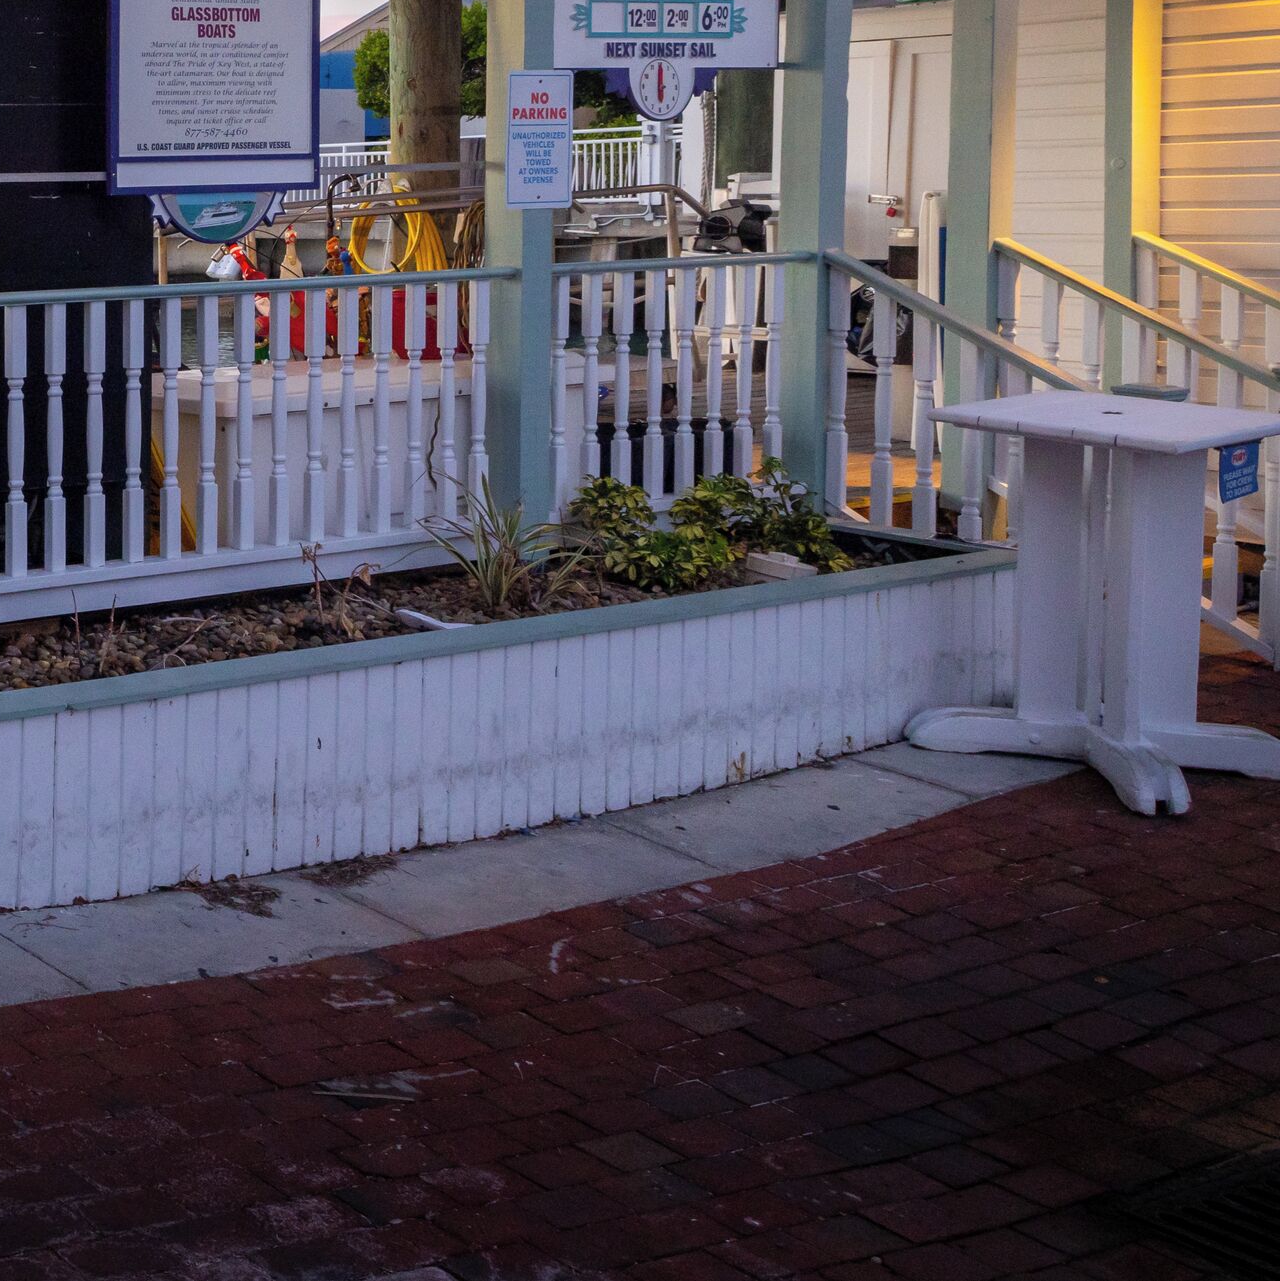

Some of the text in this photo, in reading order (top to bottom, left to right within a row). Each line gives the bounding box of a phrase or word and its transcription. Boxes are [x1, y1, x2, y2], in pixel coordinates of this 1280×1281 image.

[171, 7, 260, 22] GLASSBOTTOM
[629, 6, 728, 30] 12:00 2:00 6:00
[198, 24, 235, 38] BOATS
[606, 42, 716, 58] NEXT SUNSET SAIL
[531, 92, 549, 104] NO
[512, 108, 567, 119] PARKING
[185, 128, 248, 138] 877-587-4460
[151, 143, 171, 151] COAST
[197, 142, 229, 150] APPROVED
[231, 142, 267, 150] PASSENGER
